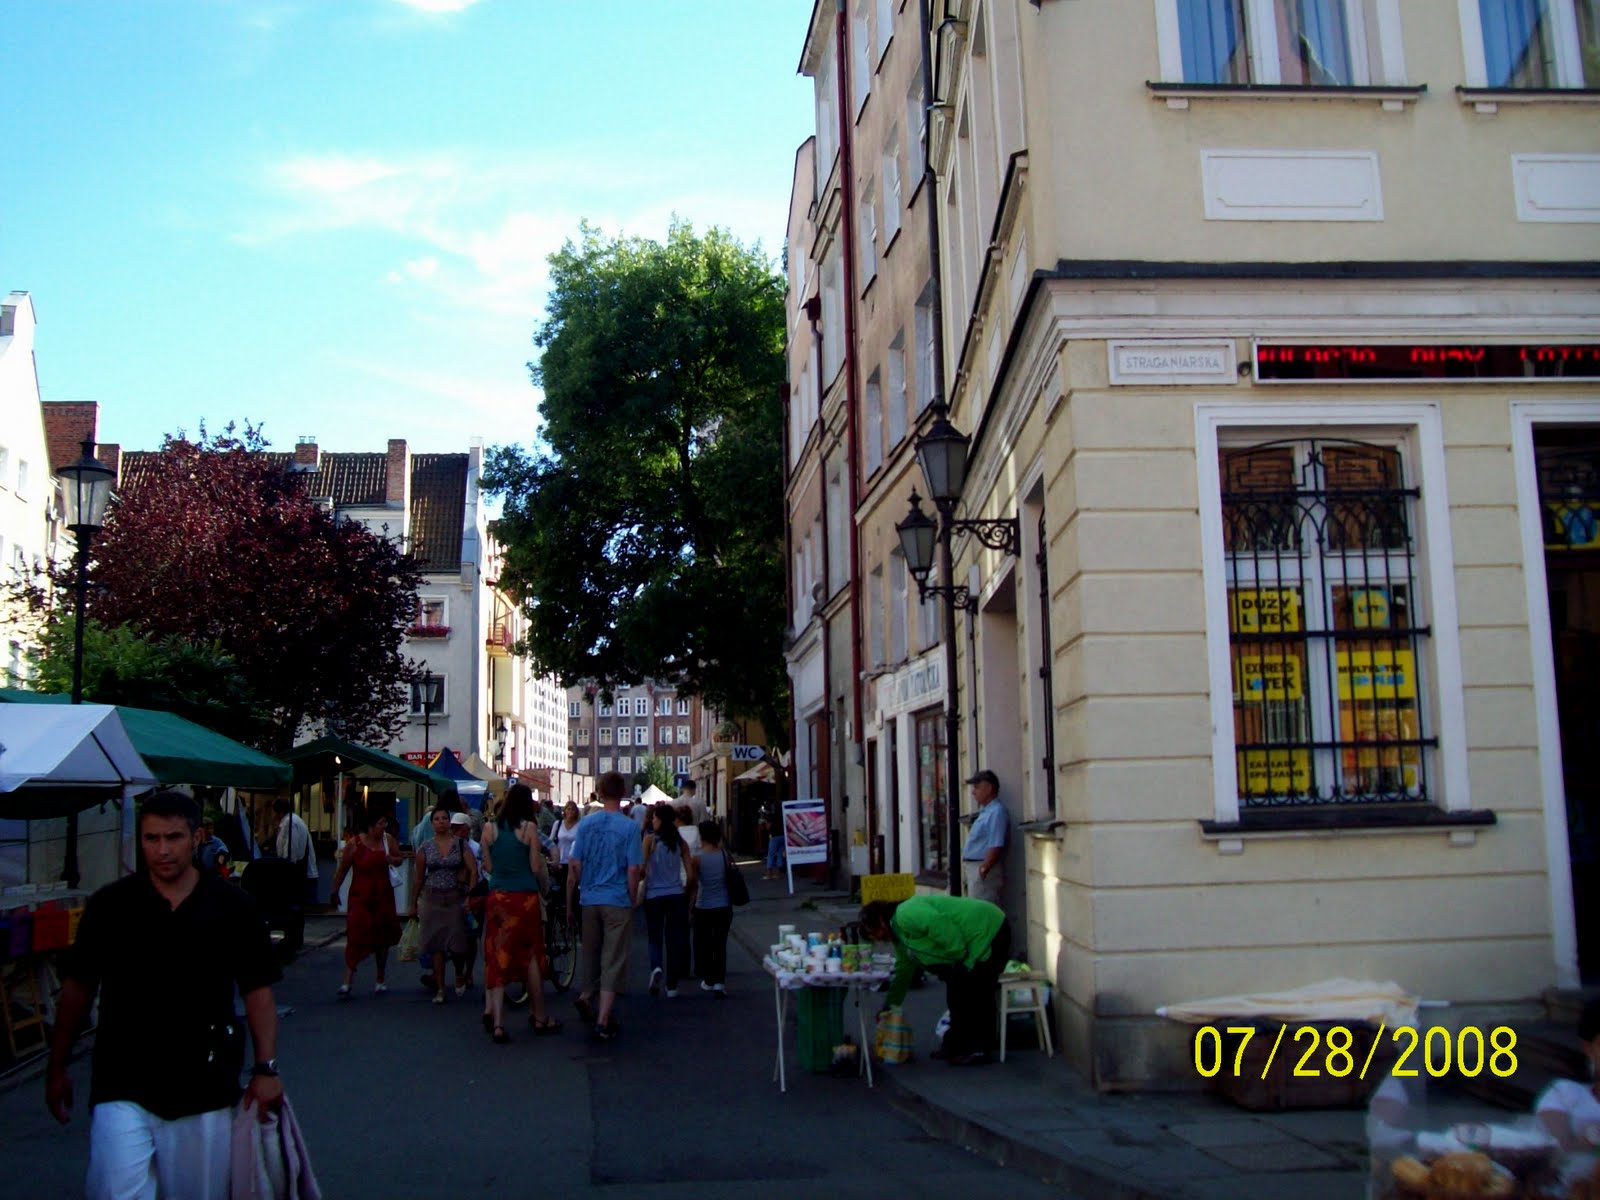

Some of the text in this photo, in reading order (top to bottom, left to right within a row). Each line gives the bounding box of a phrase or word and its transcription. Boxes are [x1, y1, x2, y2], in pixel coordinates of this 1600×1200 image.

[1125, 356, 1220, 369] STRAGANIARSKA
[1245, 662, 1295, 674] EXRES
[734, 746, 759, 759] WC
